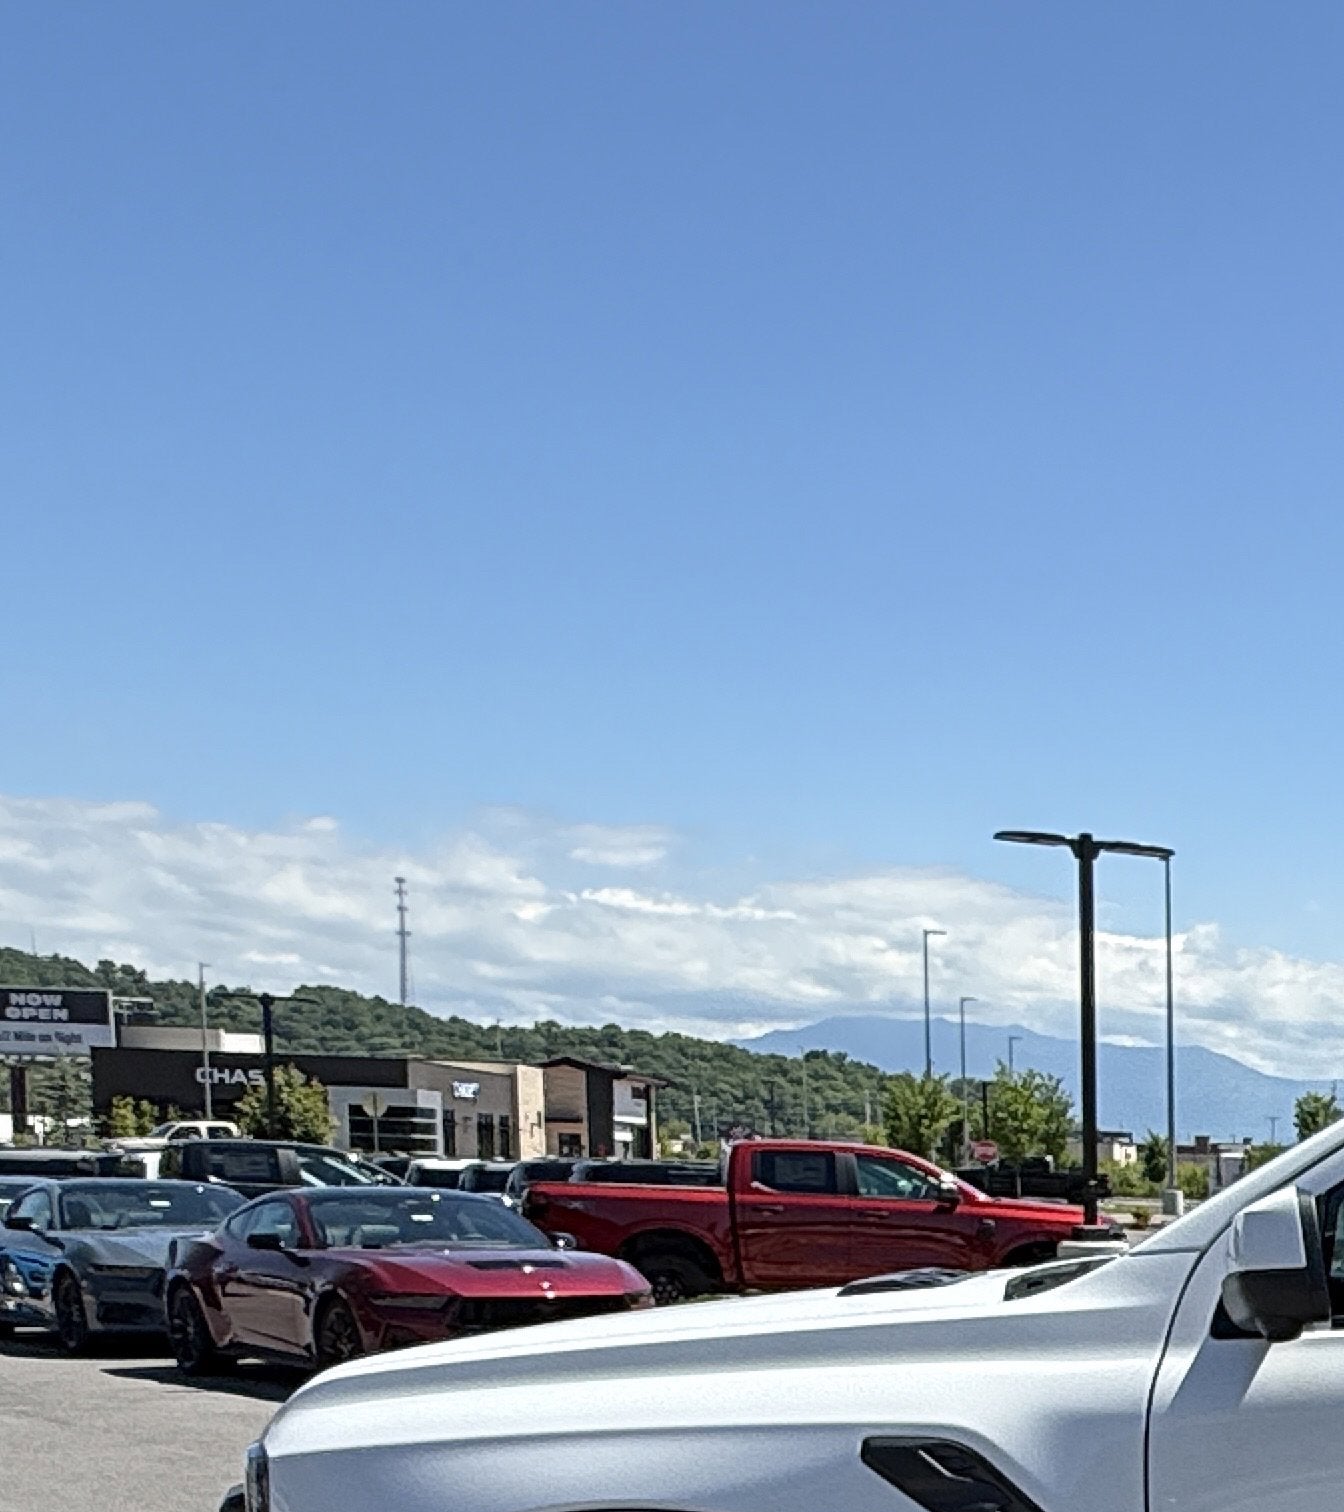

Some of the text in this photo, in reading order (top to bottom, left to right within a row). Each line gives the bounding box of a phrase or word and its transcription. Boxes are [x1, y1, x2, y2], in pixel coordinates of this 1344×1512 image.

[9, 992, 63, 1006] NOW
[5, 1006, 69, 1020] OPEN
[196, 1066, 266, 1087] CHAS
